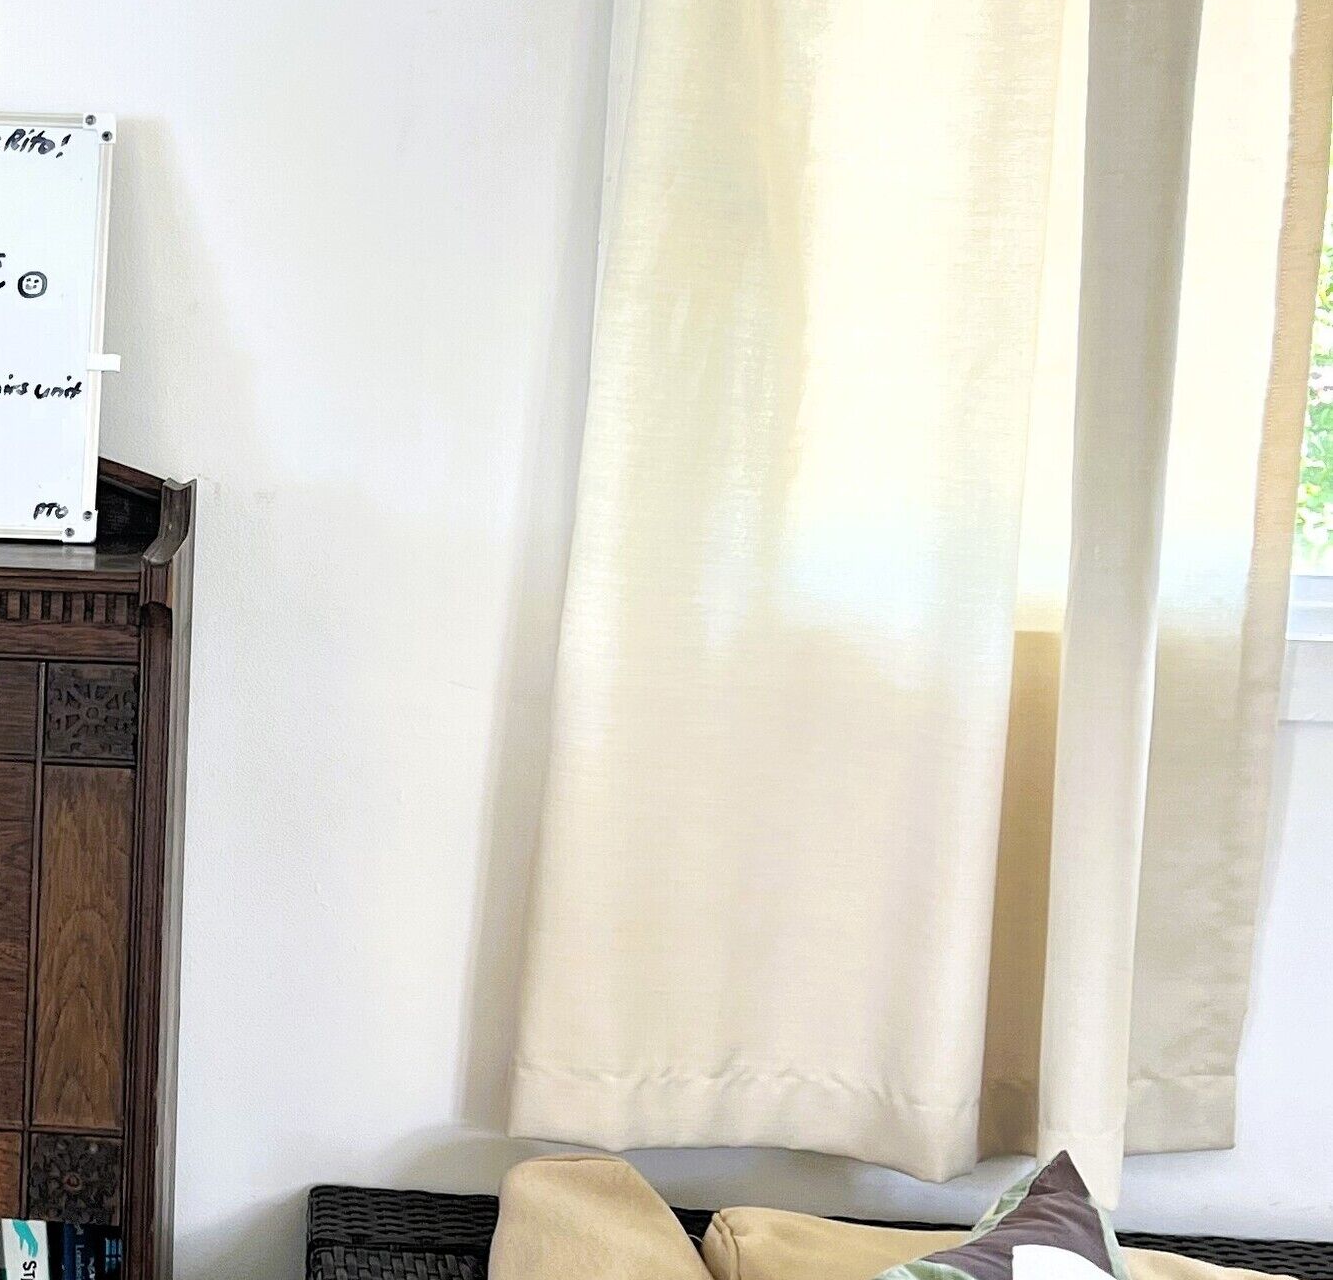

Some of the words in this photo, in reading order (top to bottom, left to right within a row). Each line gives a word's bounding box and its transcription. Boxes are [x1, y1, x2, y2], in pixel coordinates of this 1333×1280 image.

[3, 128, 73, 160] Rito!
[33, 375, 83, 400] unit
[33, 502, 69, 521] PTO
